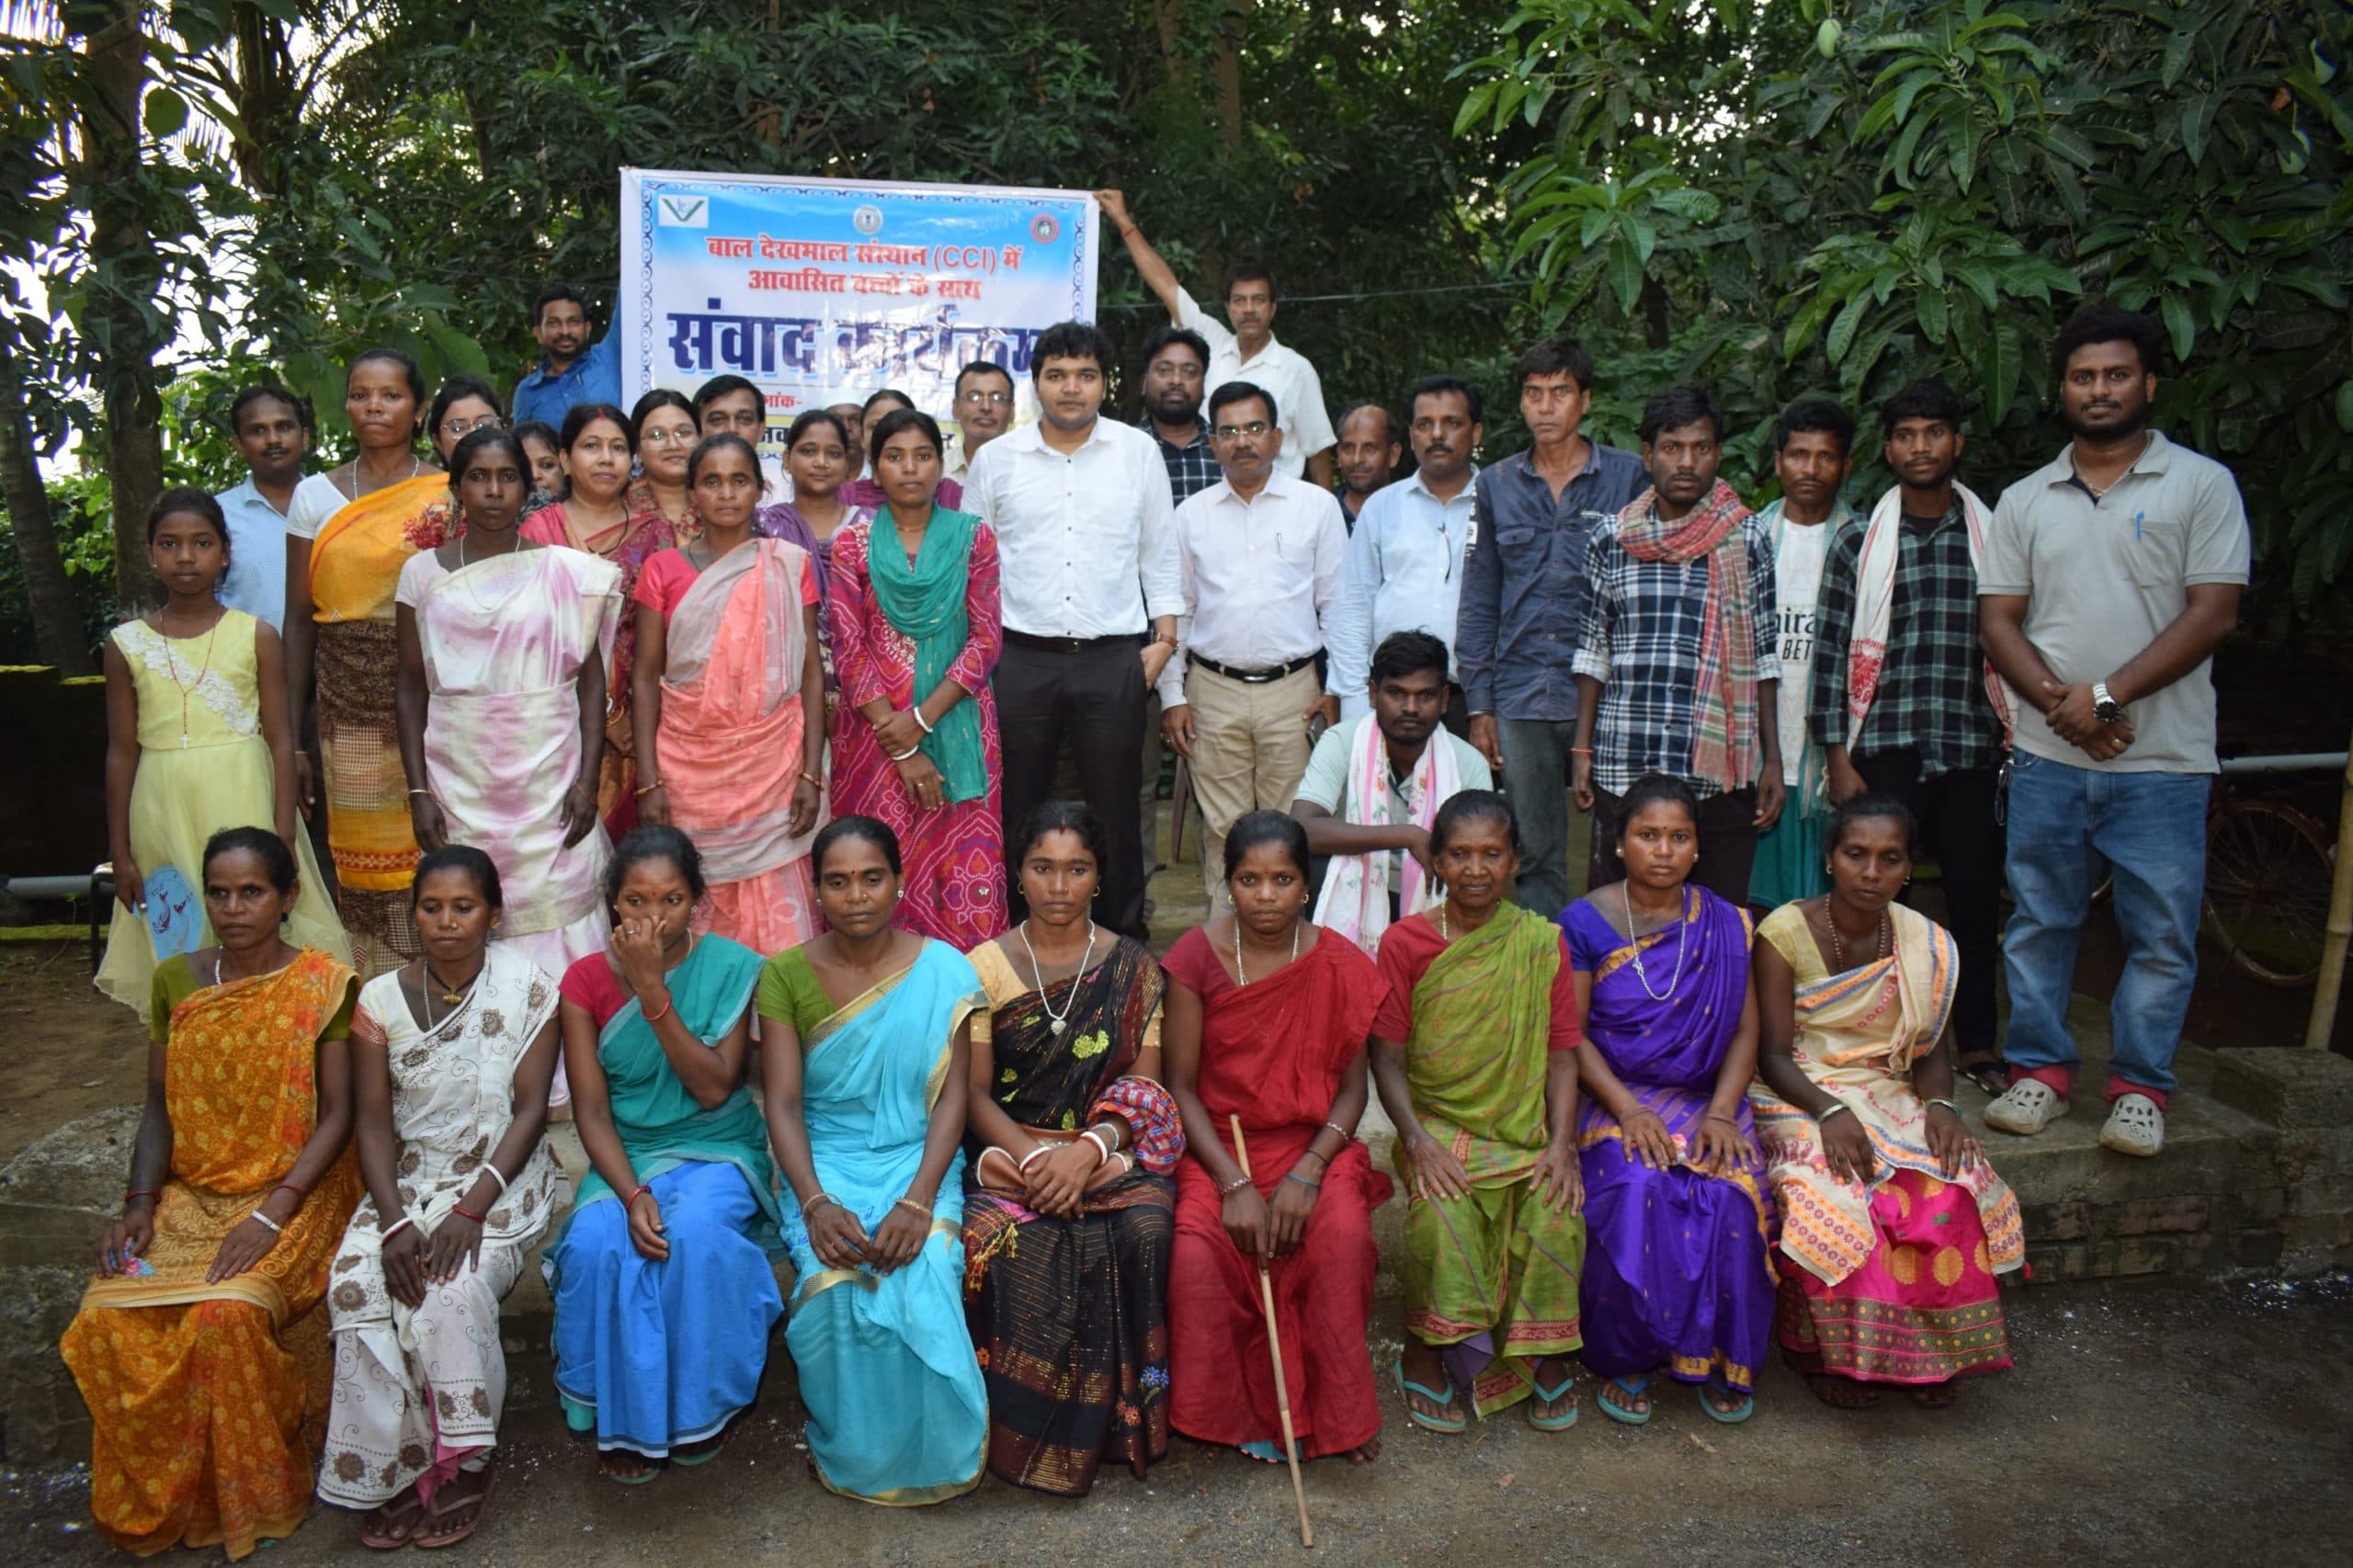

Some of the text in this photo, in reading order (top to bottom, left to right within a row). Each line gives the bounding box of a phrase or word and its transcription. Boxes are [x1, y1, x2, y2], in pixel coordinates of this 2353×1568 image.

[705, 233, 1023, 276] बाल देखभाल संस्थान (CCI) में
[748, 267, 847, 293] आवासित
[907, 273, 929, 298] के
[666, 297, 822, 375] संवाद
